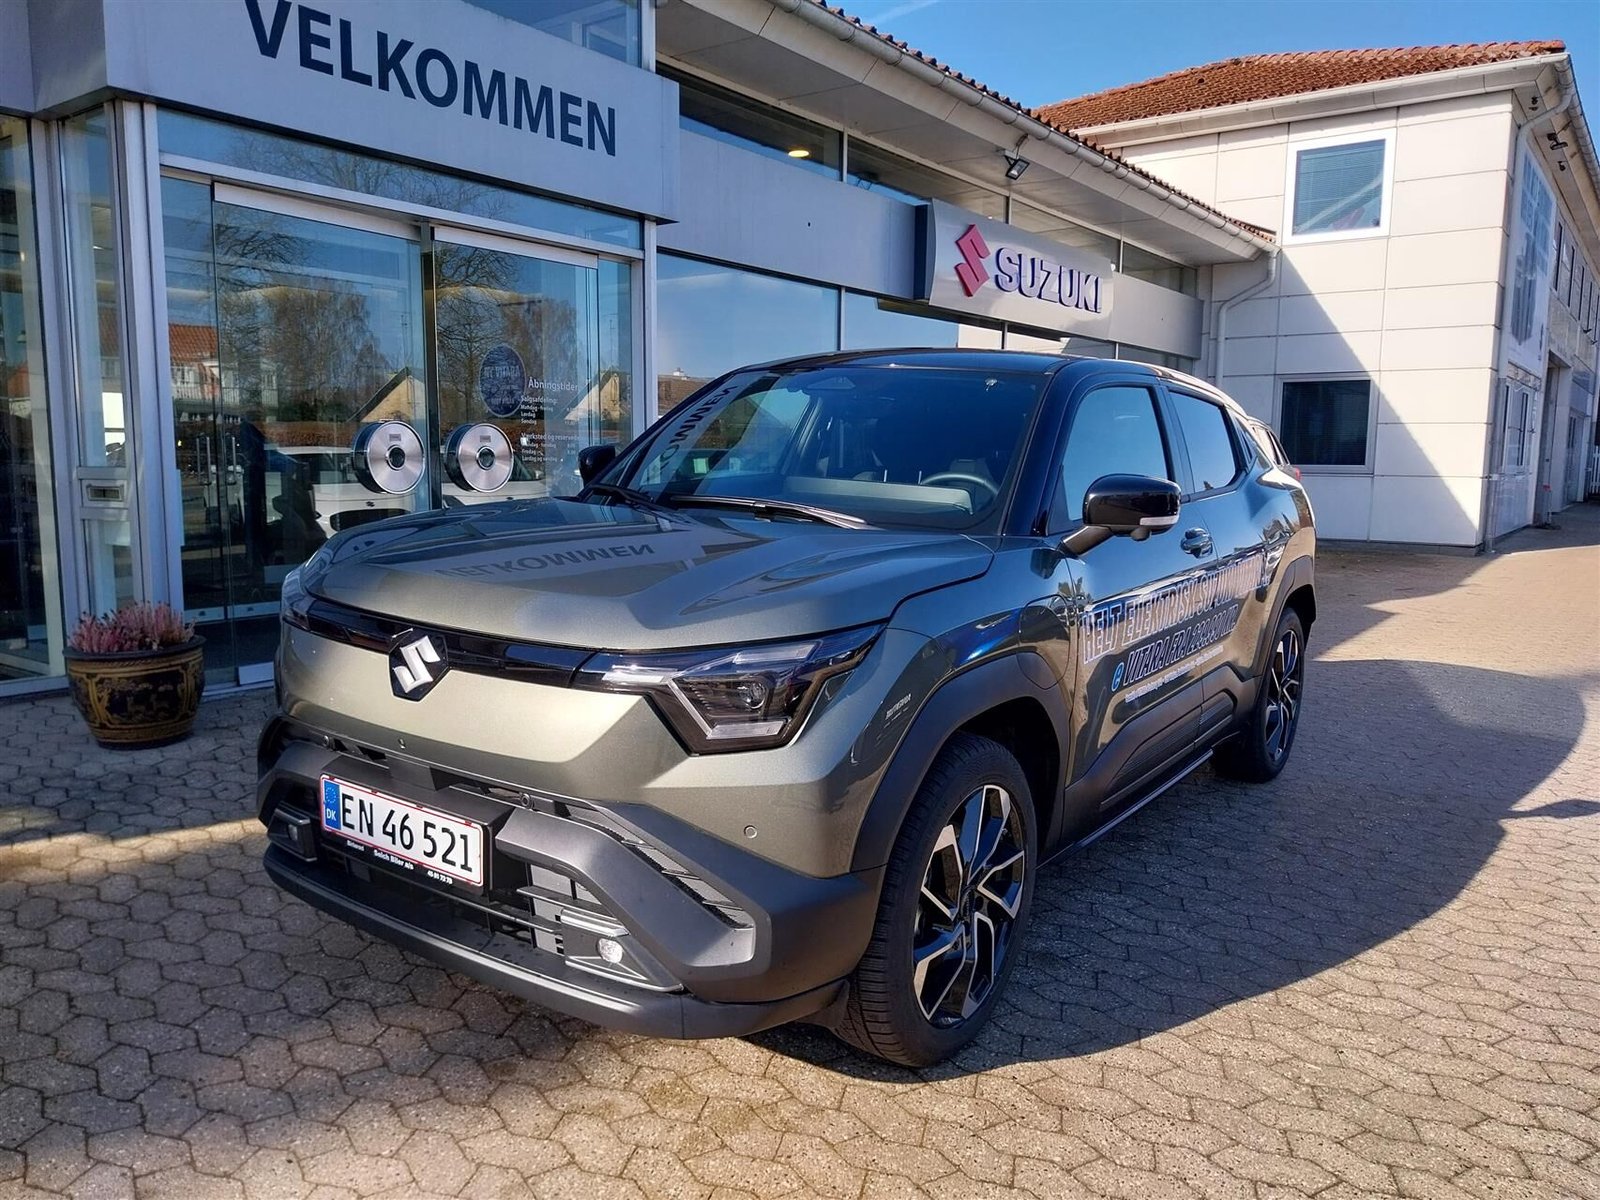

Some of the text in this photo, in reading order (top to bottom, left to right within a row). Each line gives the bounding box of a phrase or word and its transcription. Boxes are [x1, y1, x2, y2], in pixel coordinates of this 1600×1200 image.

[244, 0, 616, 157] VELKOMMEN
[994, 247, 1103, 313] SUZUKI
[528, 376, 578, 392] Åbningstider
[1080, 603, 1122, 665] HELT
[1122, 636, 1171, 687] VITARA
[1169, 626, 1192, 664] FRA
[326, 808, 337, 822] DK
[341, 792, 473, 873] EN 46 521
